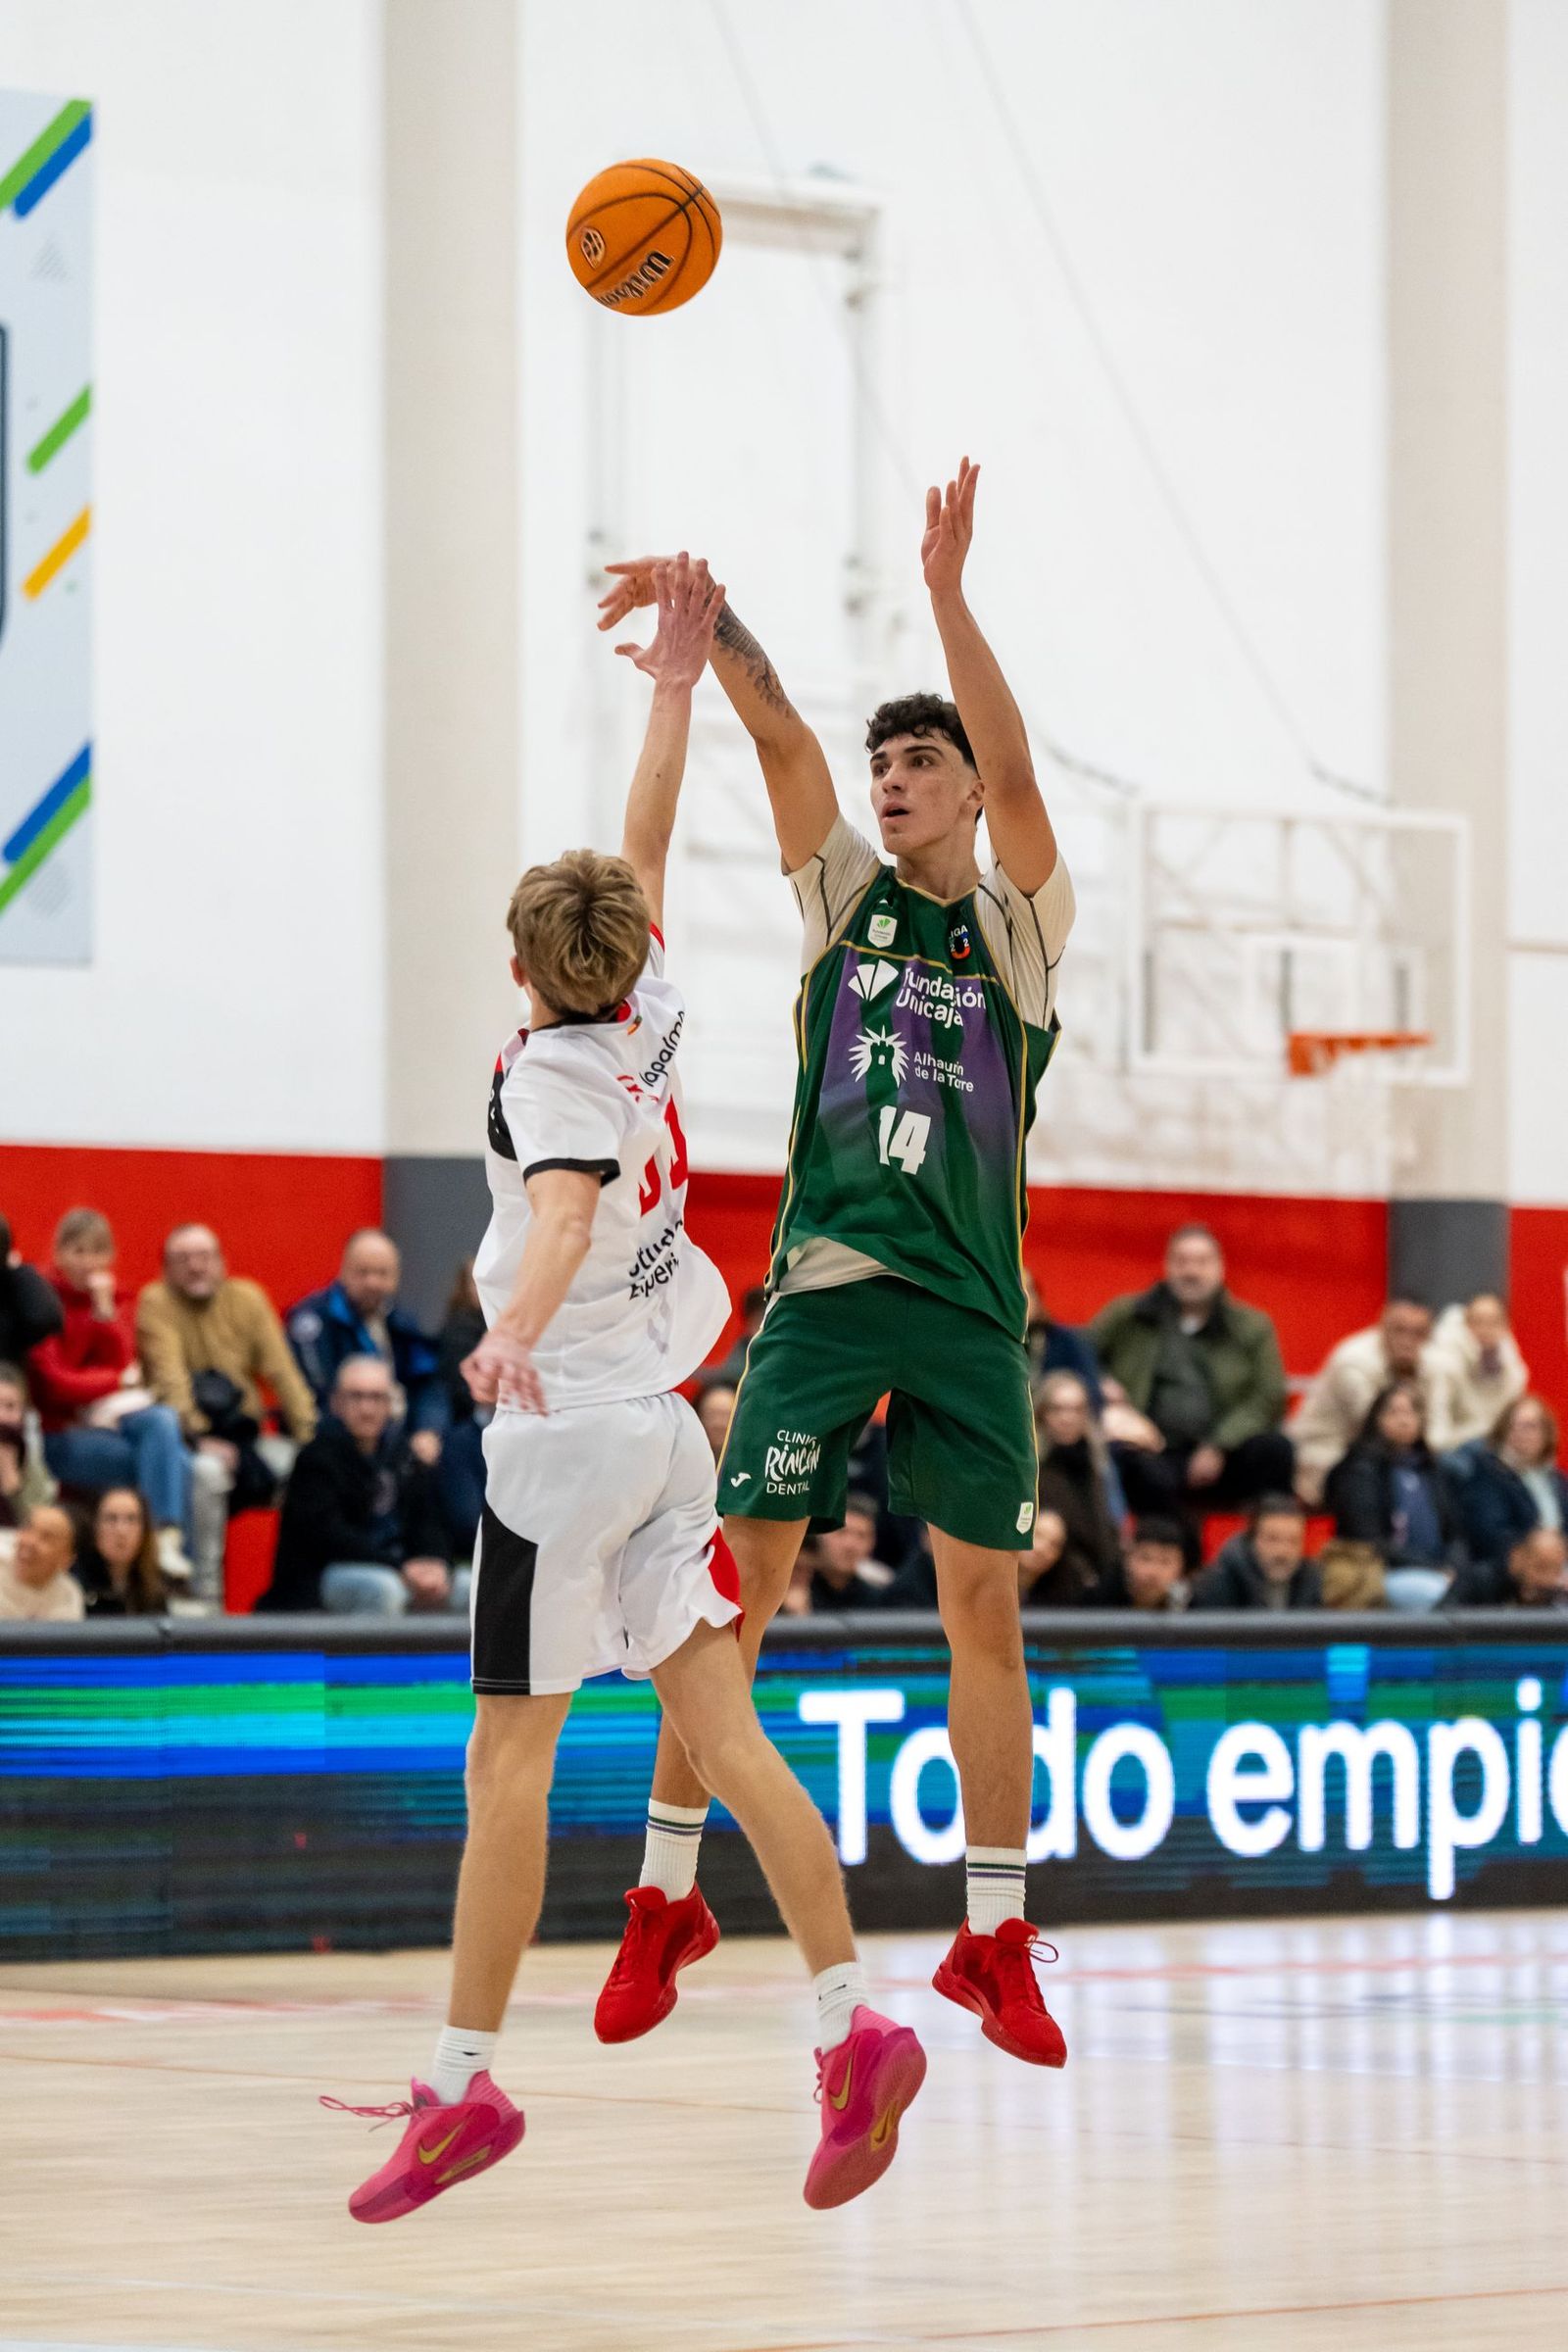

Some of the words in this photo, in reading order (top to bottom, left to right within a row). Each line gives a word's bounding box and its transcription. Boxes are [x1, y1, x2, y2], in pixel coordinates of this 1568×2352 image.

[896, 988, 963, 1029] Unicaja
[914, 1065, 929, 1080] de
[933, 1068, 946, 1083] la
[878, 1104, 932, 1175] 14
[766, 1480, 810, 1495] DENTAL
[1206, 1677, 1568, 1900] empi
